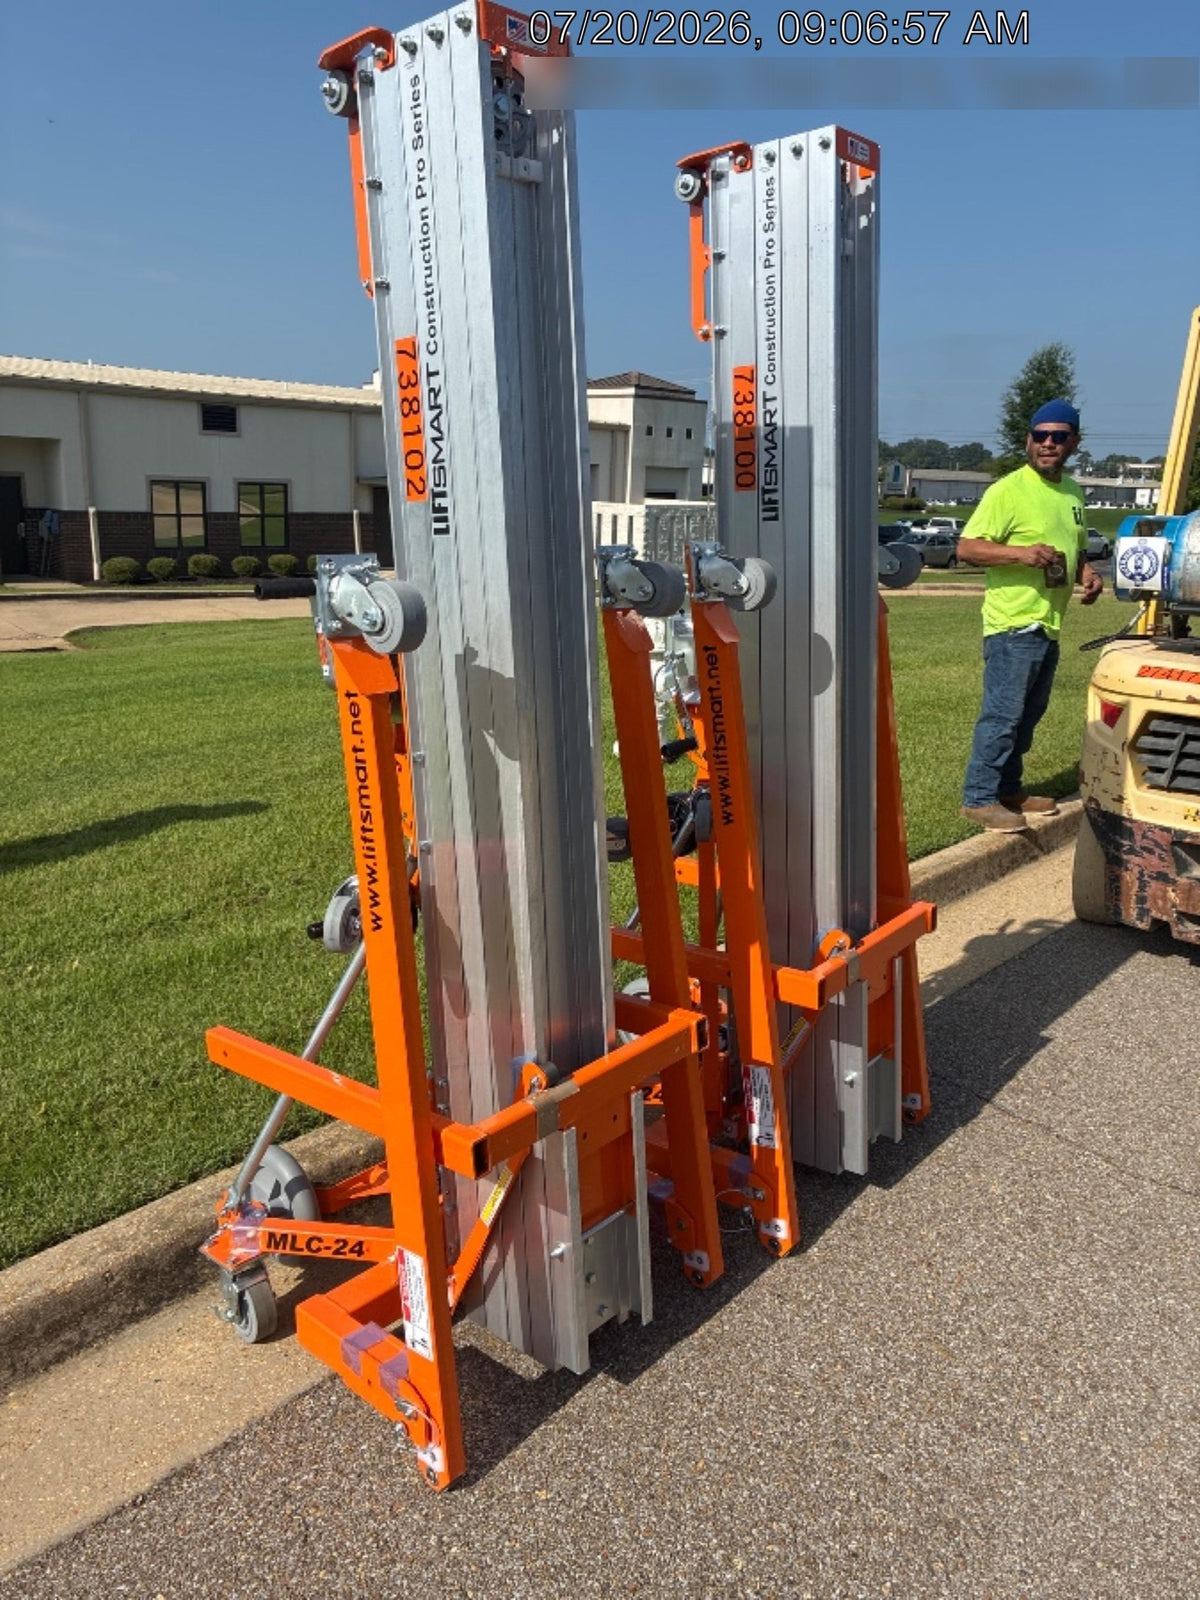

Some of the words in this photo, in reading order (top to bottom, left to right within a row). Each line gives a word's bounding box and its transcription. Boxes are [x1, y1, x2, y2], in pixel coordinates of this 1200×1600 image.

[410, 74, 425, 151] Series
[415, 158, 428, 200] Pro
[763, 176, 777, 233] Series
[418, 205, 438, 356] Construction
[763, 238, 776, 270] Pro
[764, 274, 777, 385] Construction
[395, 341, 427, 496] 738102
[426, 363, 450, 535] LIFTSMART
[734, 369, 756, 488] 738100
[762, 391, 780, 521] LIFTSMART
[702, 645, 734, 826] www.liftsmart.net
[344, 689, 384, 932] www.liftsmart.net
[266, 1231, 366, 1258] MLC-24
